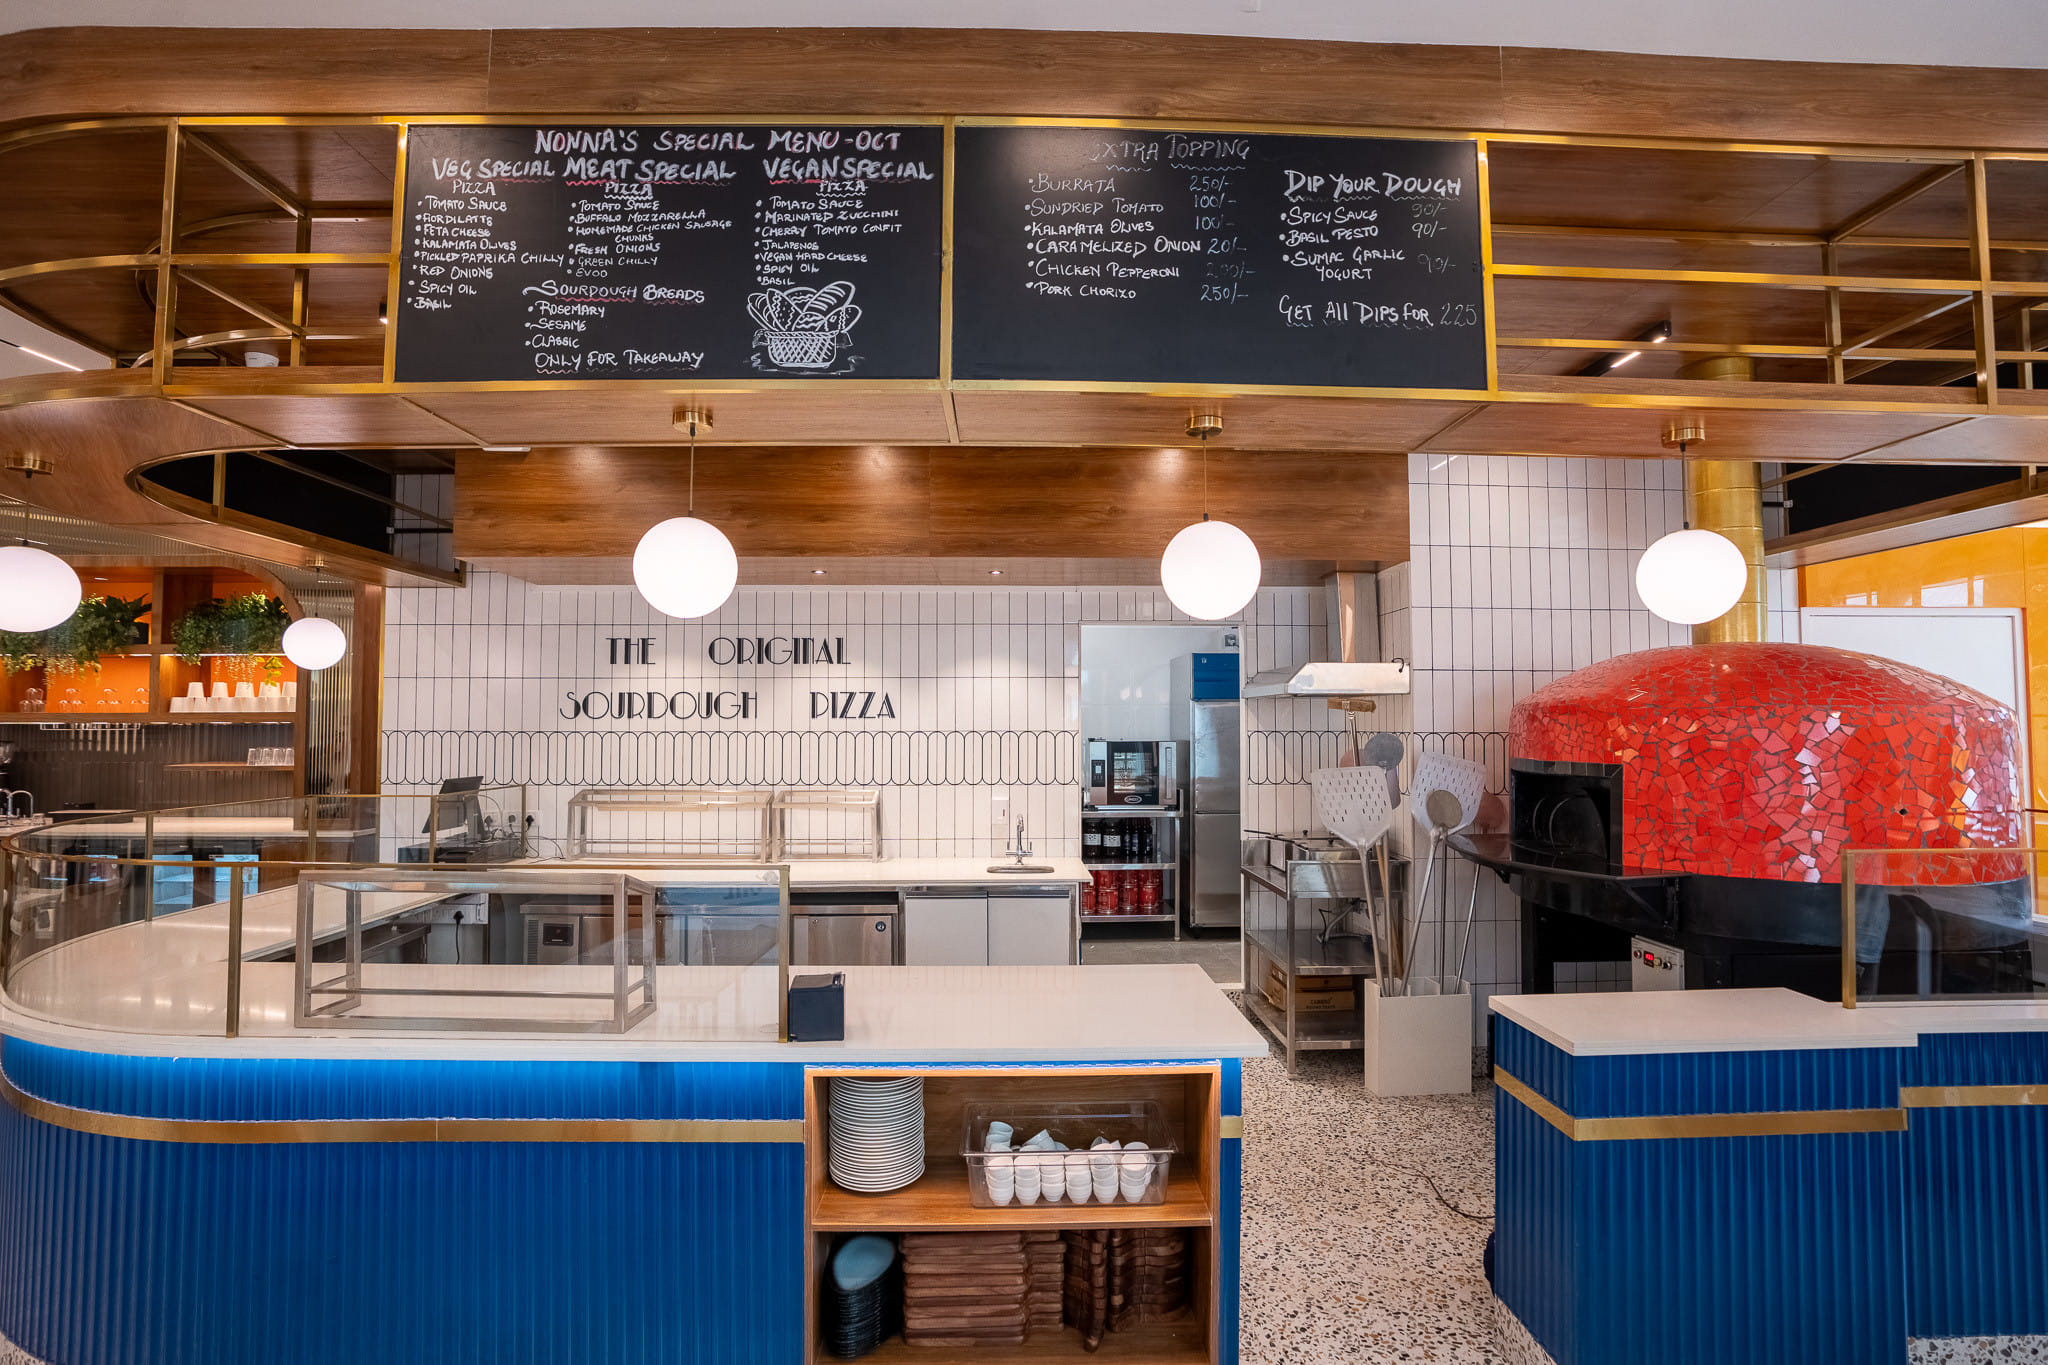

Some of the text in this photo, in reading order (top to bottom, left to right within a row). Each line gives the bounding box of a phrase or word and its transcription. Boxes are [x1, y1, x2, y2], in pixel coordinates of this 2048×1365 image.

[535, 128, 639, 155] NONNA'S
[653, 130, 754, 152] SPECIAL
[1164, 133, 1250, 160] TOPPING
[432, 158, 555, 180] VEG SPECIAL
[562, 157, 736, 181] MEAT SPECIAL
[762, 156, 934, 179] VEGAN SPECIAL
[453, 179, 496, 195] PIZZA
[604, 182, 653, 196] PIZZA
[820, 180, 866, 192] PIZZA
[1032, 172, 1115, 193] BURRATA
[1284, 170, 1461, 199] DIP YOUR DOUGH
[425, 195, 507, 212] TOMATO SAUCE
[578, 200, 660, 211] TOMATO SAUCE
[769, 196, 864, 210] TOMATO SAUCE
[1030, 198, 1104, 216] SUNDRIED
[1112, 197, 1164, 215] TOMATO
[575, 213, 621, 224] BUFFALO
[765, 211, 834, 224] MARINATED
[1286, 206, 1331, 225] SPICY
[1333, 206, 1378, 224] SAUCE
[424, 224, 491, 237] FETA CHEESE
[636, 222, 679, 232] CHICKEN
[761, 225, 807, 237] CHERRY
[863, 223, 902, 233] CONFIT
[1031, 221, 1104, 236] KALAMATA
[1110, 218, 1154, 233] OLIVES
[1154, 235, 1201, 253] ONION
[1285, 229, 1329, 247] BASIL
[1332, 225, 1378, 241] PESTO
[422, 238, 517, 251] KALAMATA OLIVES
[574, 242, 661, 255] FRESH ONIONS
[762, 239, 819, 250] JALAPENOS
[461, 253, 516, 264] PAPRIKA
[521, 252, 564, 267] CHILLY
[578, 256, 658, 268] GREEN CHILLY
[760, 252, 868, 263] VEGAN HARD CHEESE
[1290, 251, 1344, 267] SUMAC
[1352, 246, 1406, 265] GARLIC
[420, 264, 494, 280] RED ONIONS
[800, 263, 820, 273] OIL
[1035, 257, 1100, 277] CHICKEN
[1106, 262, 1179, 279] PEPPERONI
[1315, 265, 1373, 281] YOGURT
[419, 279, 477, 295] SPICY OIL
[761, 276, 795, 285] BASIL
[522, 280, 705, 303] SOURDOUGH BREADS
[1033, 281, 1072, 296] PORK
[1079, 284, 1136, 299] CHORIZO
[414, 297, 452, 311] BASIL
[535, 300, 605, 318] ROSEMARY
[1279, 295, 1312, 323] GET
[1440, 303, 1477, 327] 225
[530, 318, 586, 332] SESAME
[532, 334, 580, 348] CLASSIC
[535, 349, 704, 371] ONLY FOR TAKEAWAY
[606, 637, 851, 665] THE ORIGINAL
[560, 691, 896, 720] SOURDOUGH PIZZA
